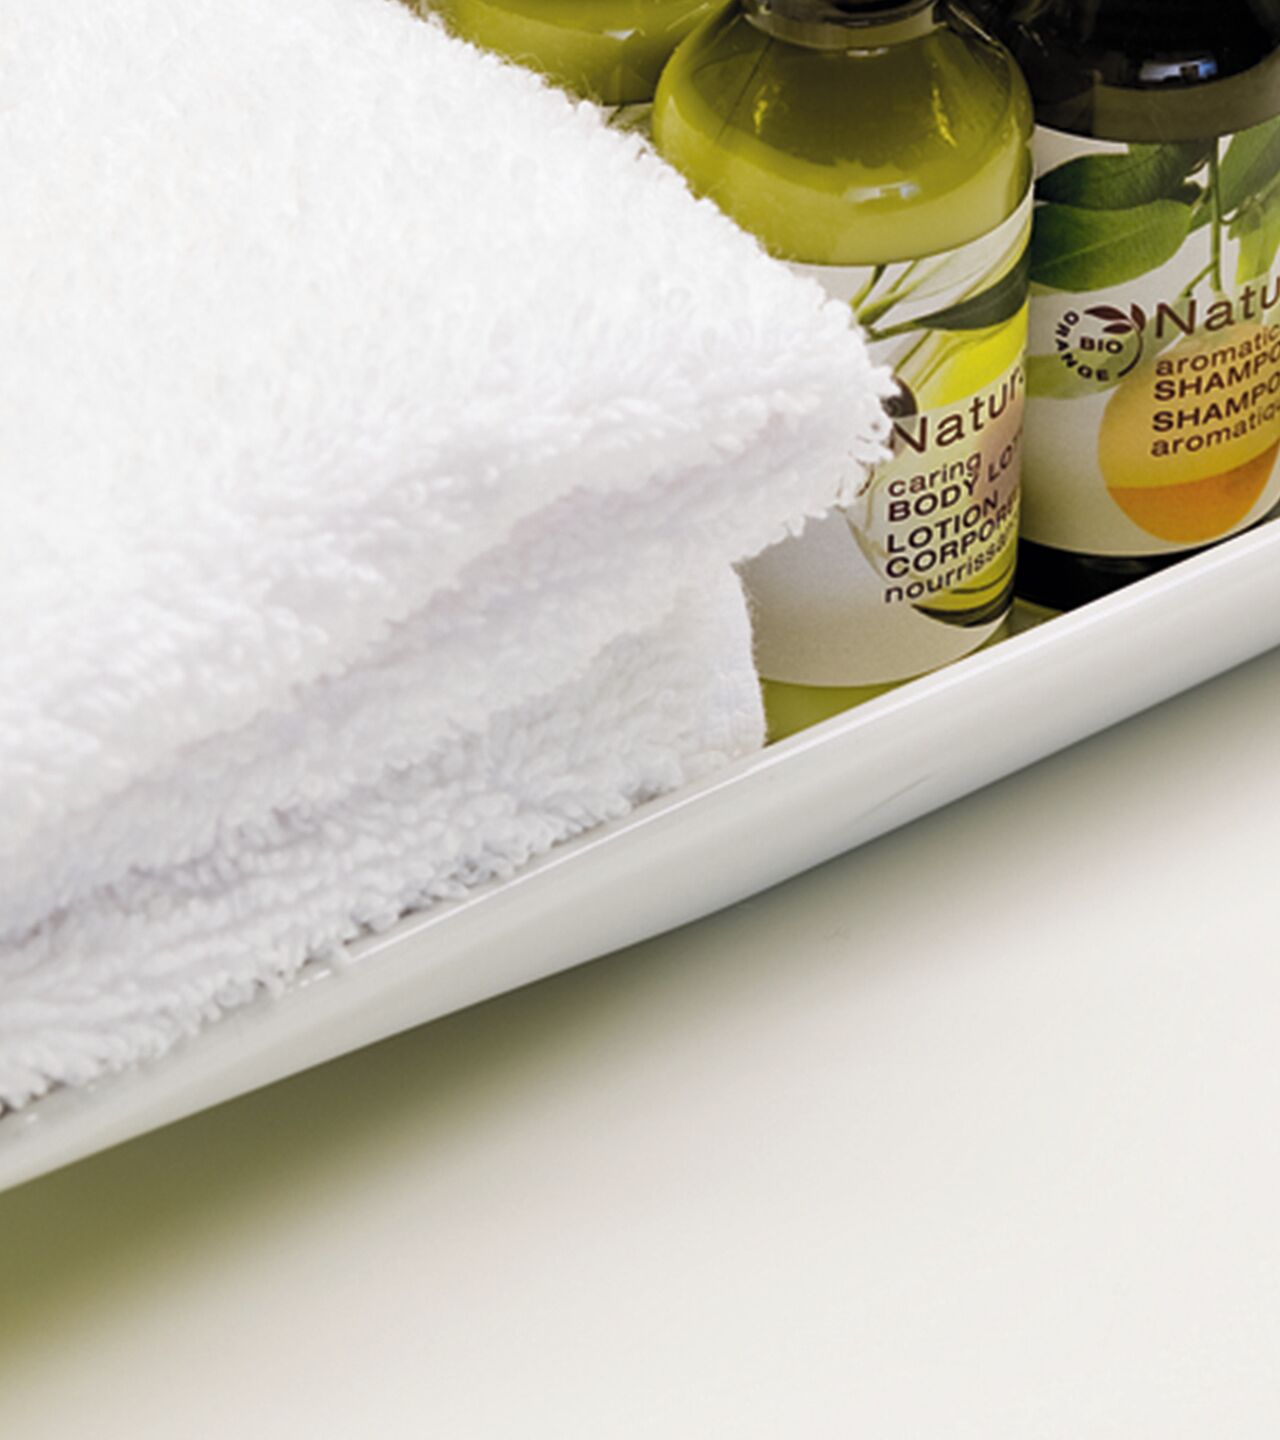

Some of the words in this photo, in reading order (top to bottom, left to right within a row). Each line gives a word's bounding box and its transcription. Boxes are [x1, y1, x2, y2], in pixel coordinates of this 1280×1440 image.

[1080, 336, 1123, 354] BIO
[1155, 324, 1280, 377] aromatic
[889, 367, 1024, 454] Natur
[888, 452, 981, 497] caring
[888, 471, 980, 522] BODY
[887, 490, 998, 554] LOTION
